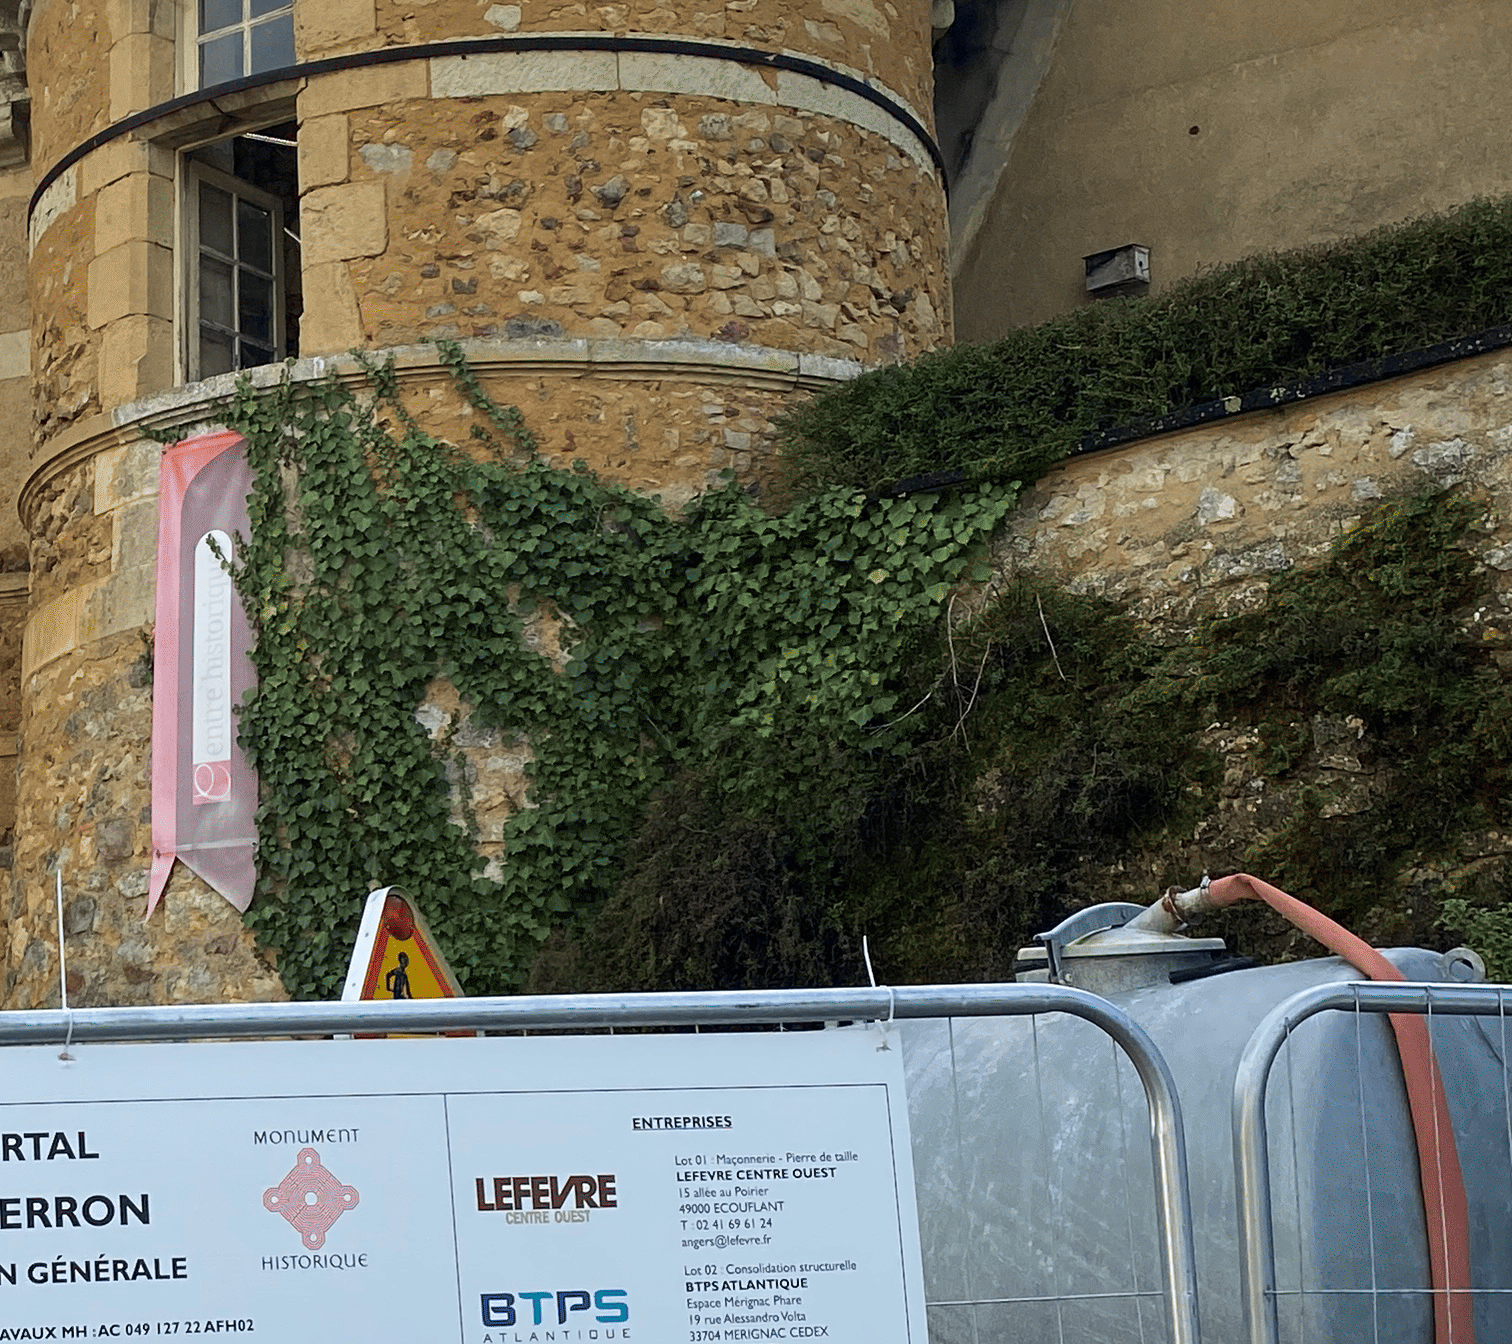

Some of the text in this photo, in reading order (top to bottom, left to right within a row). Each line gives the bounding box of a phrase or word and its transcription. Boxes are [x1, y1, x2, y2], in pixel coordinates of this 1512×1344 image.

[632, 1115, 733, 1130] ENTREPRISES
[253, 1128, 360, 1145] MONUMENT
[676, 1166, 838, 1182] LEFEVRE CENTRE OUEST
[475, 1174, 618, 1212] LEFEVRE
[505, 1210, 591, 1226] CENTRE OUEST
[27, 1253, 188, 1285] GÉNÉRALE
[261, 1252, 369, 1271] HISTORIQUE
[685, 1277, 809, 1293] BTPS ATLANTIQUE
[479, 1289, 629, 1328] BTPS
[61, 1325, 88, 1339] MH
[97, 1324, 121, 1338] AC
[125, 1322, 151, 1337] 049
[157, 1321, 180, 1335] 127
[184, 1320, 202, 1334] 22
[203, 1318, 255, 1334] AFH02
[482, 1327, 631, 1344] ATLANTIQUE
